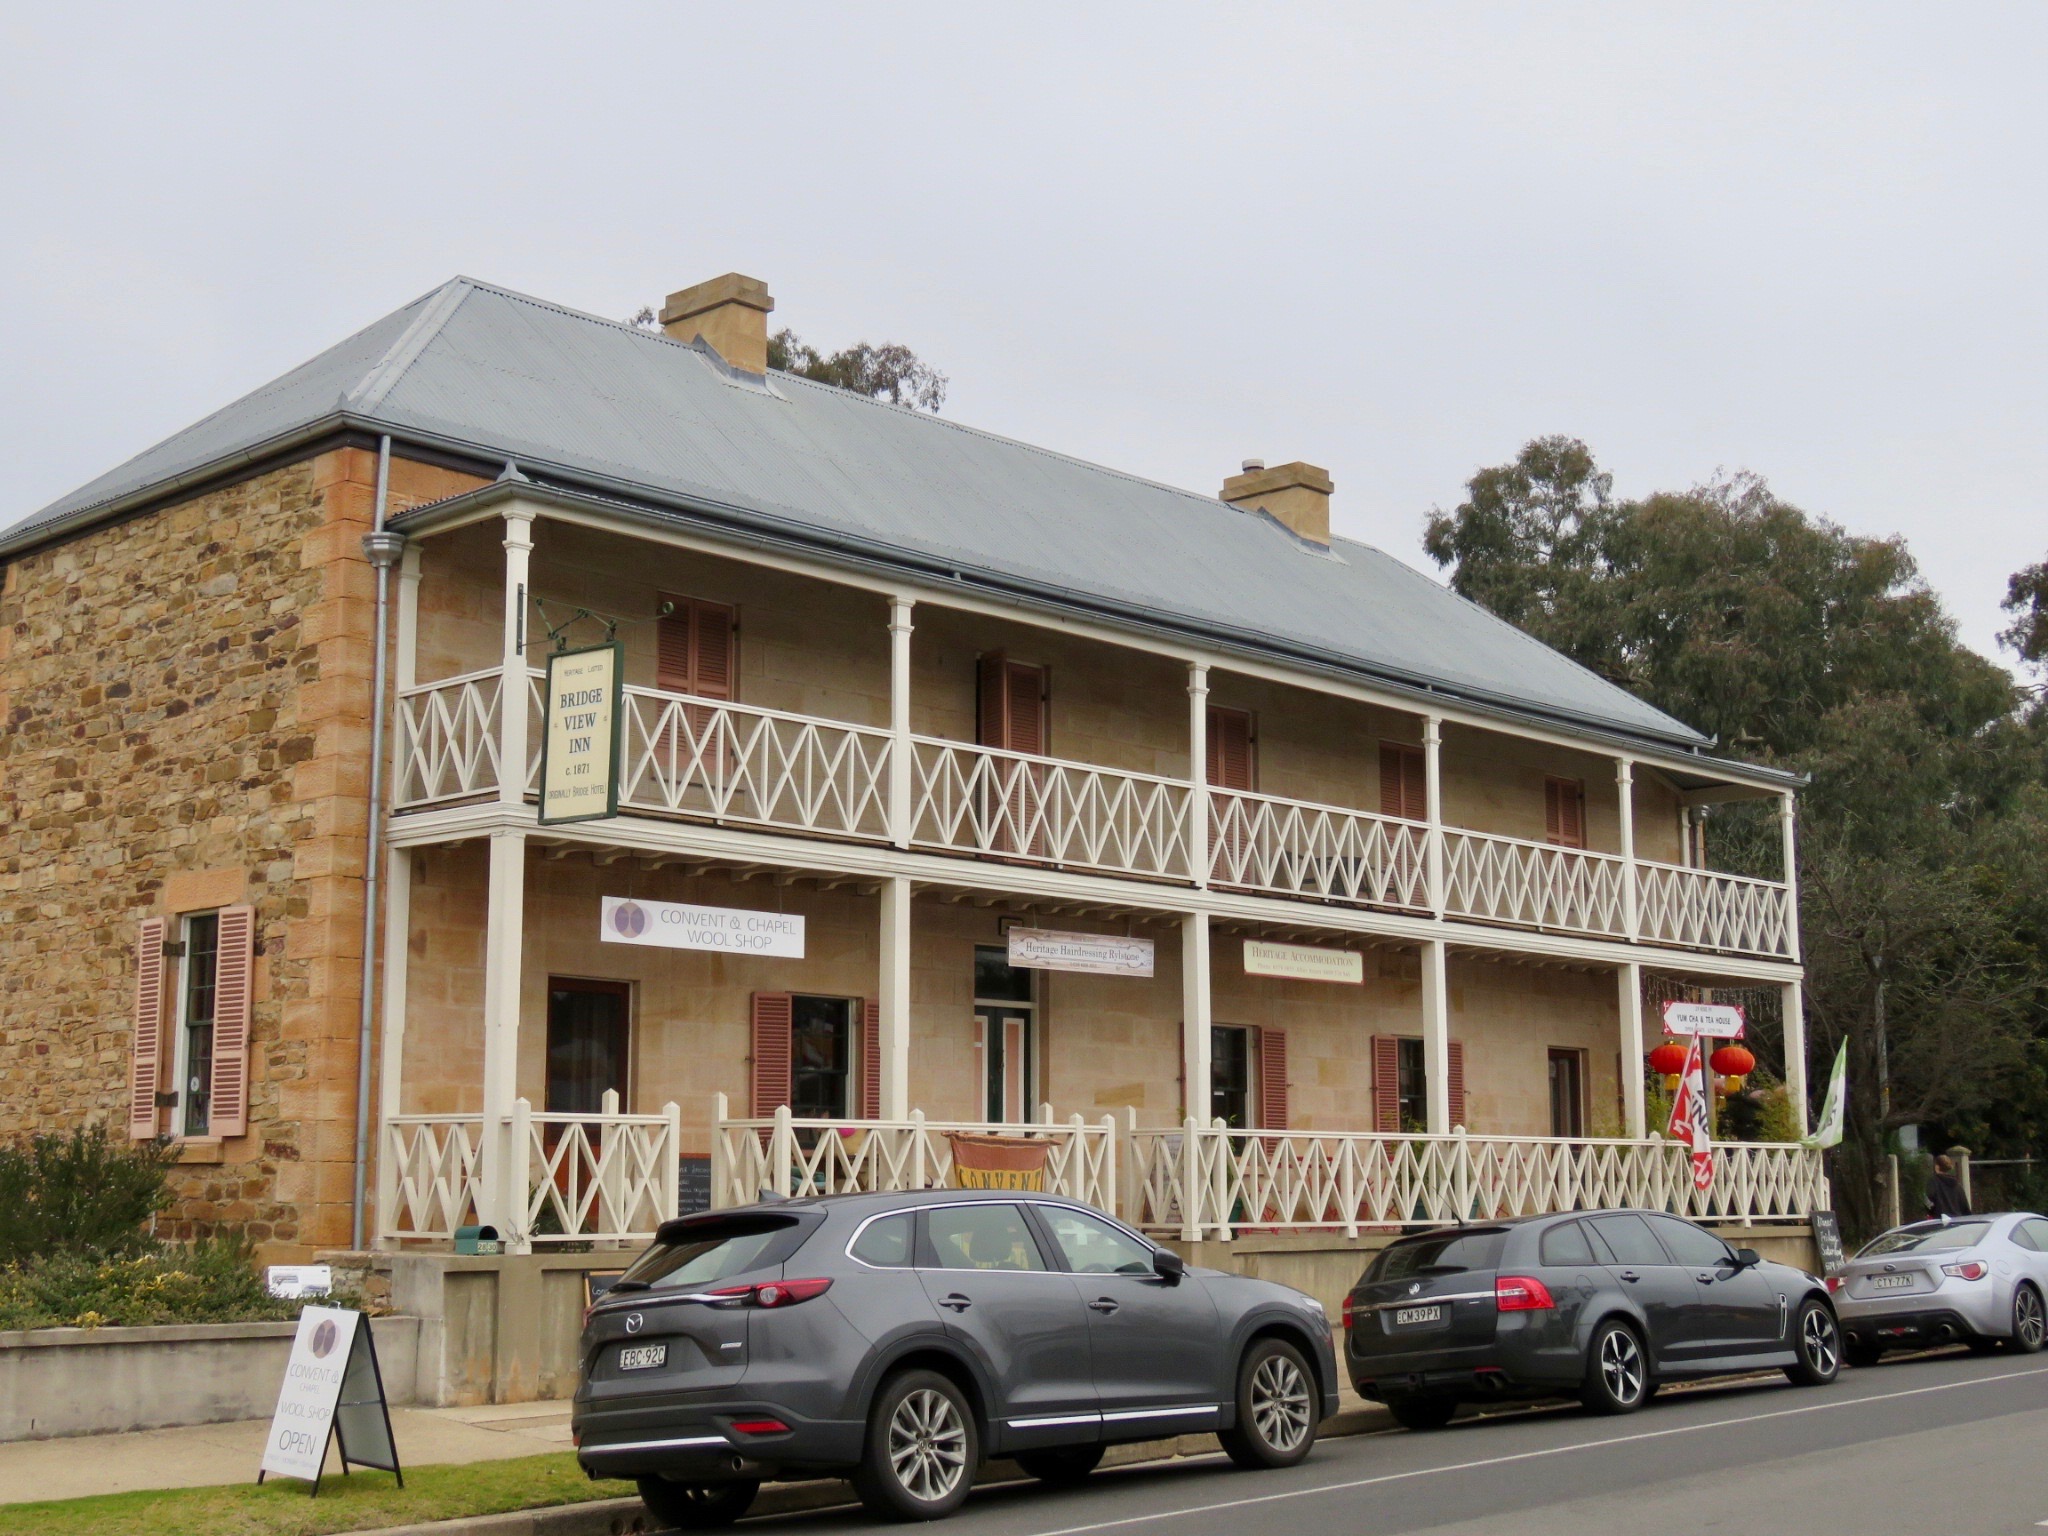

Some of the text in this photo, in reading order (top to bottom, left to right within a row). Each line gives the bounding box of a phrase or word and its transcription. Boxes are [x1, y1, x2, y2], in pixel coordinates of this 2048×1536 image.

[560, 688, 603, 709] BRIDGE
[564, 712, 597, 731] VIEW
[569, 737, 591, 754] INN
[573, 763, 590, 775] 1871
[660, 909, 796, 935] CONVENT & CHAPEL
[687, 929, 773, 950] WOOL SHOP
[1026, 941, 1140, 961] Heritage Hairdressing Rylstone
[1677, 1014, 1688, 1022] YUM
[1689, 1015, 1699, 1023] CHA
[1705, 1016, 1714, 1024] TEA
[1715, 1017, 1731, 1025] HOUSE
[290, 1363, 332, 1383] CONVENT
[300, 1382, 321, 1395] CHAPEL
[281, 1402, 332, 1420] WOOL SHOP
[279, 1430, 317, 1456] OPEN
